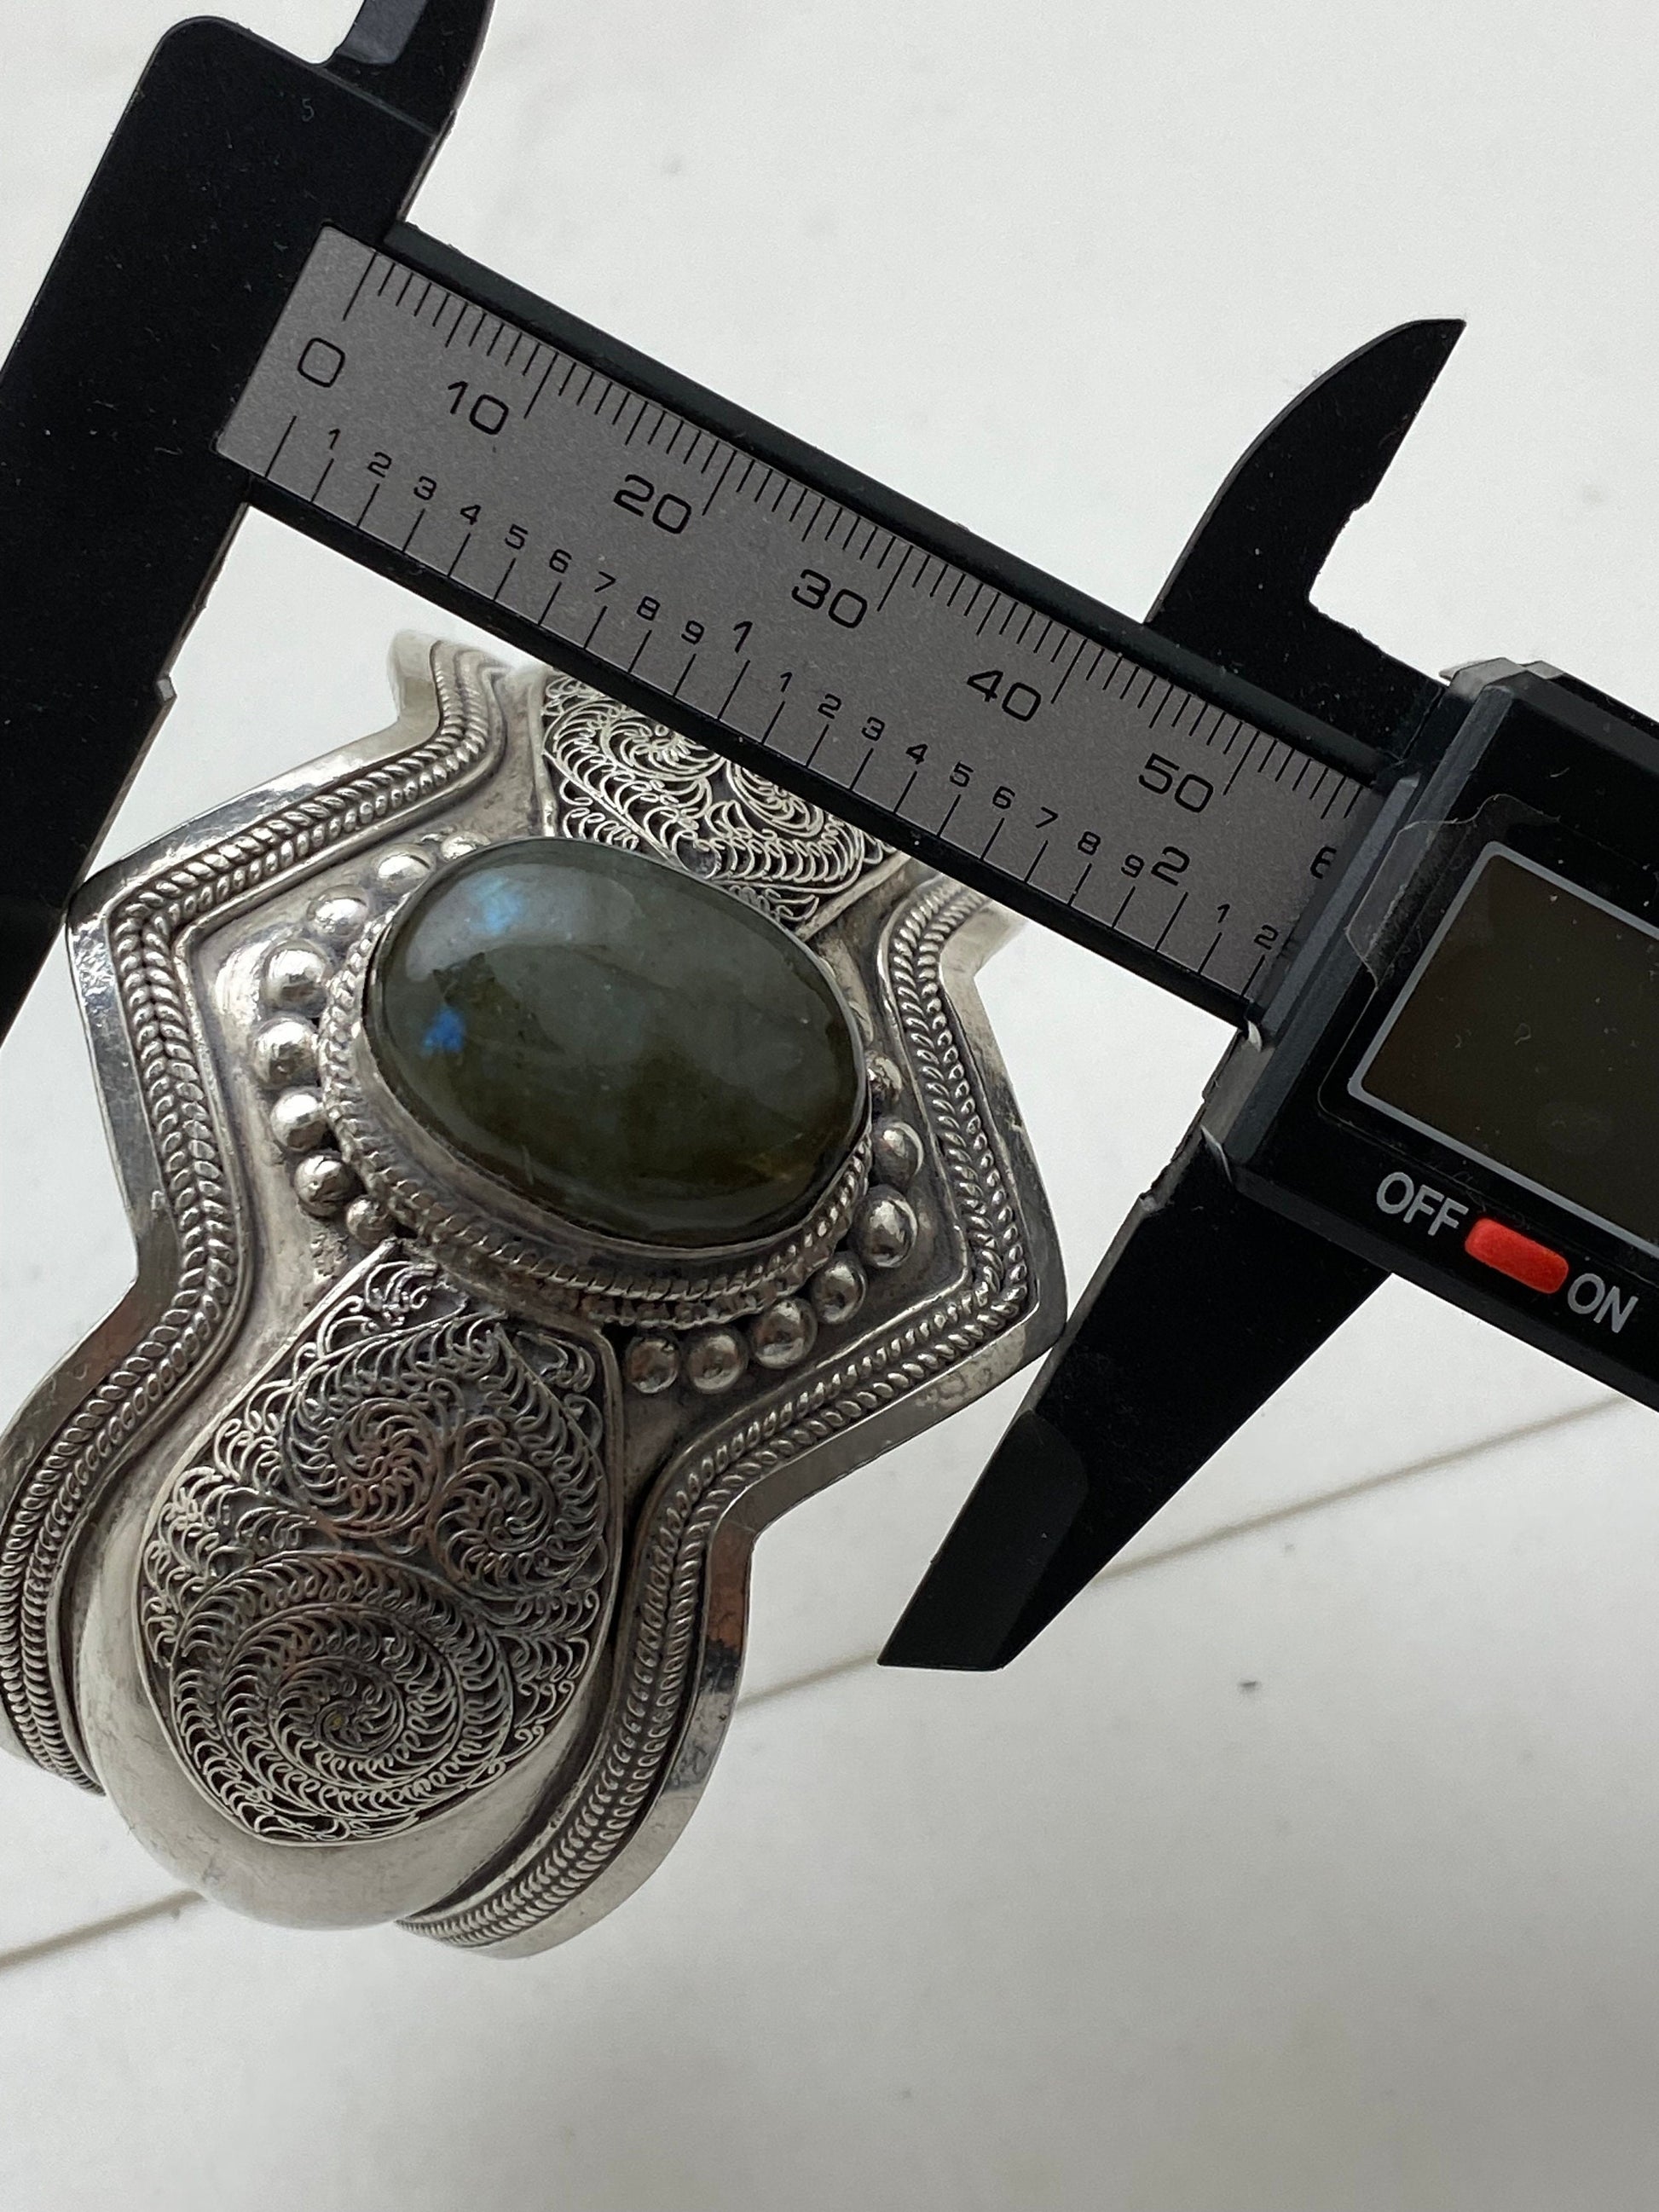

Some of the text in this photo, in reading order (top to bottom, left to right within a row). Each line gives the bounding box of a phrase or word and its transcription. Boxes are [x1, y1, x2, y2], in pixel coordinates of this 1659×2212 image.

[297, 337, 346, 389] 0
[447, 380, 510, 436] 10
[612, 474, 692, 534] 20
[791, 569, 868, 629] 30
[966, 669, 1042, 723] 40
[1138, 752, 1214, 814] 50
[328, 428, 1279, 951] 1 2 3 4 5 6 7 8 9 1 1 2 3 4 5 6 7 8 9 2 1 2
[1376, 1171, 1639, 1333] OFF ON
